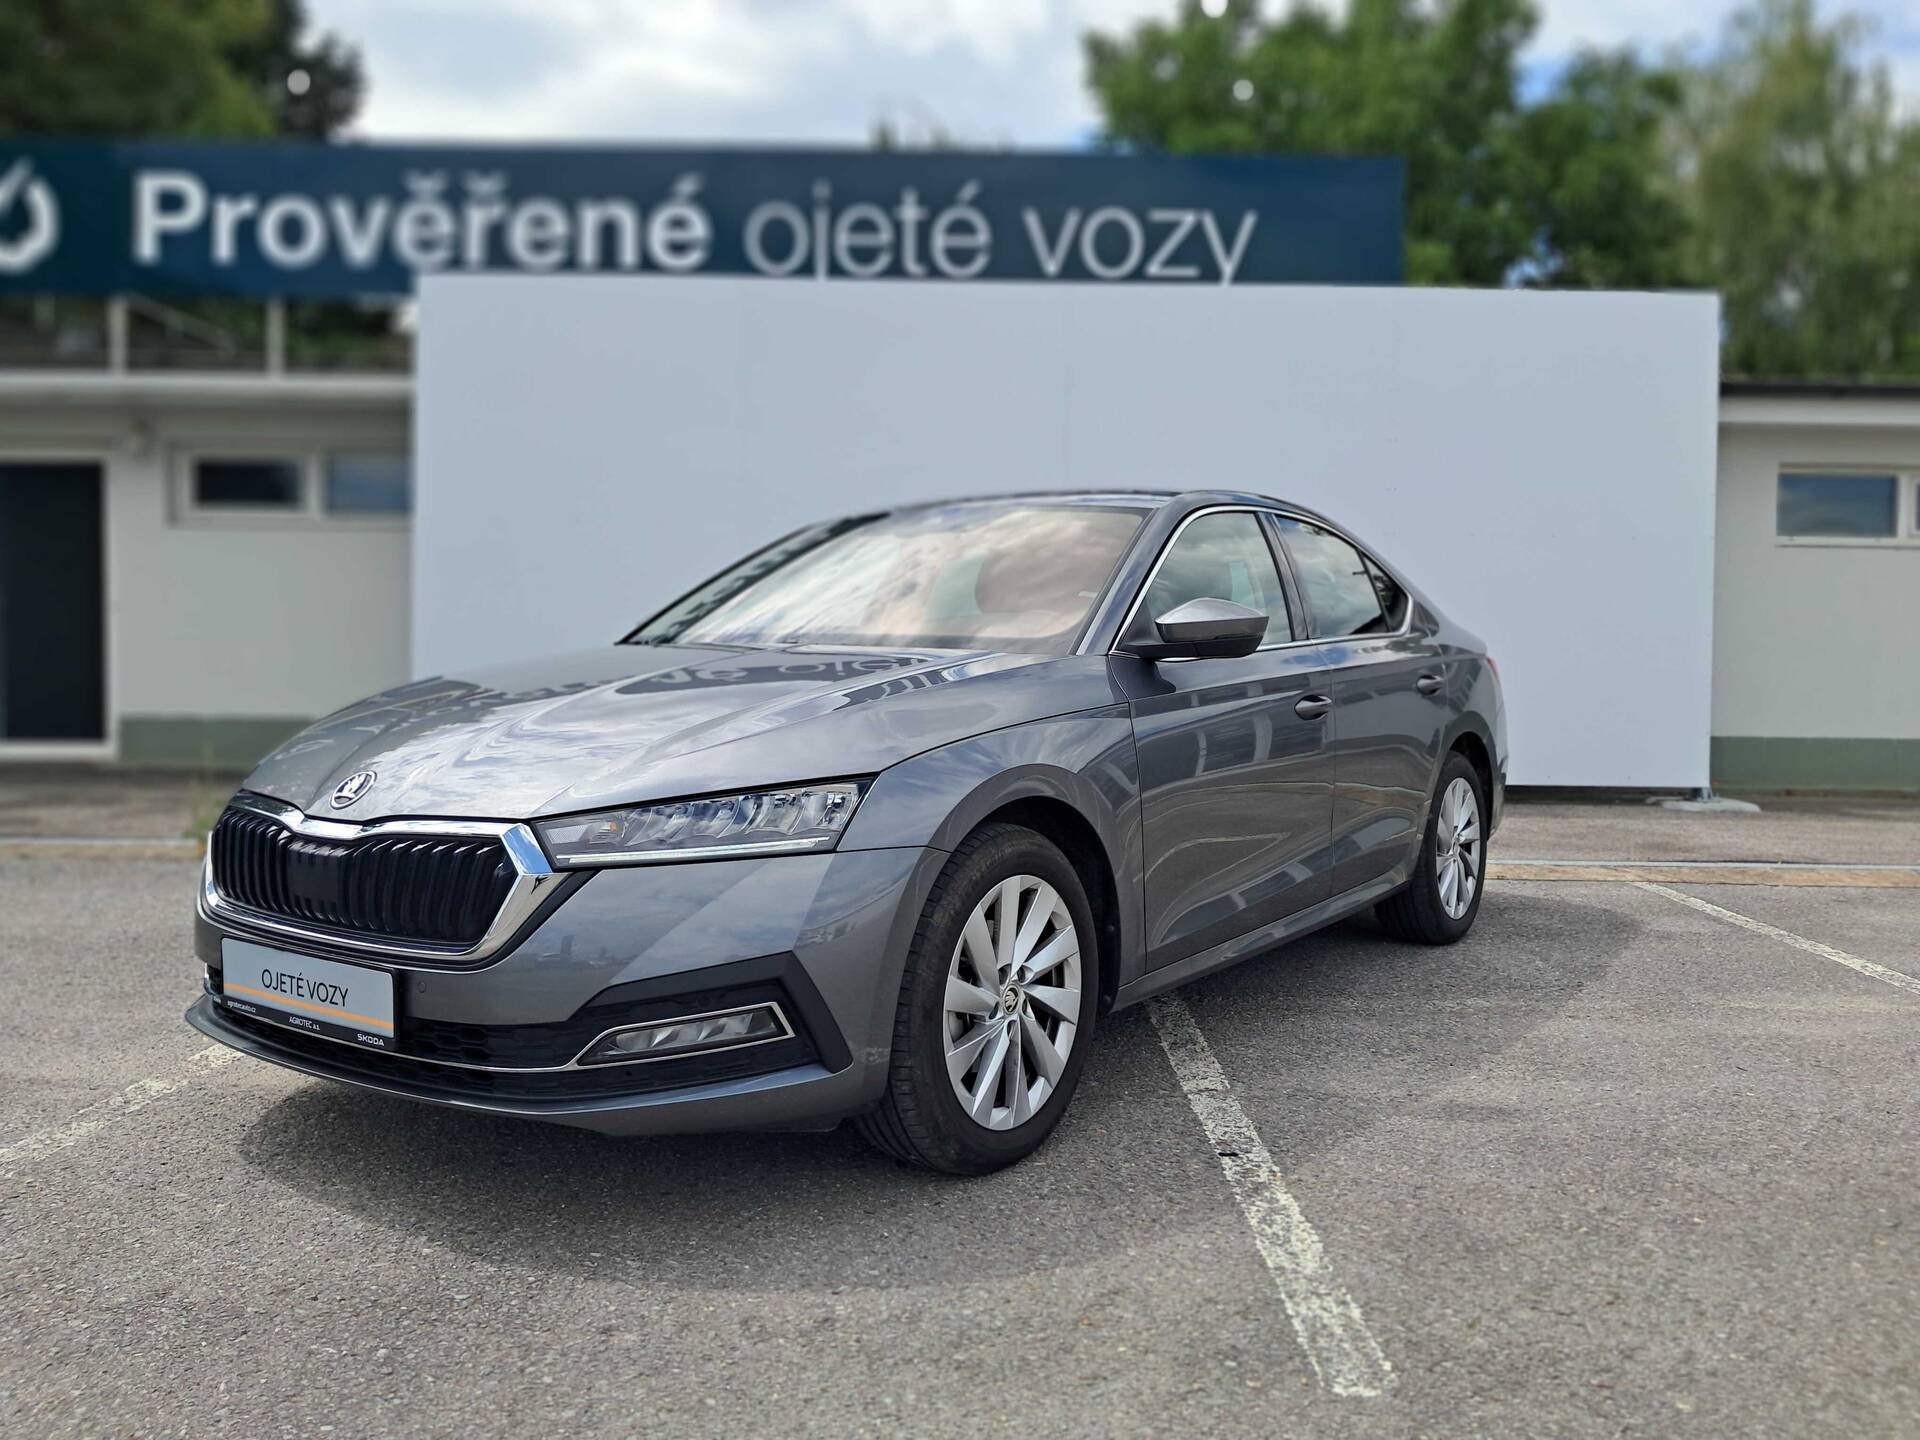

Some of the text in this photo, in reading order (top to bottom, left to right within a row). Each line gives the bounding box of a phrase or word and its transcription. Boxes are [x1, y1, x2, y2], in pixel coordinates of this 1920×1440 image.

[132, 172, 1259, 285] Prověřené ojeté vozy
[261, 969, 348, 1007] OJETÉ VOZY
